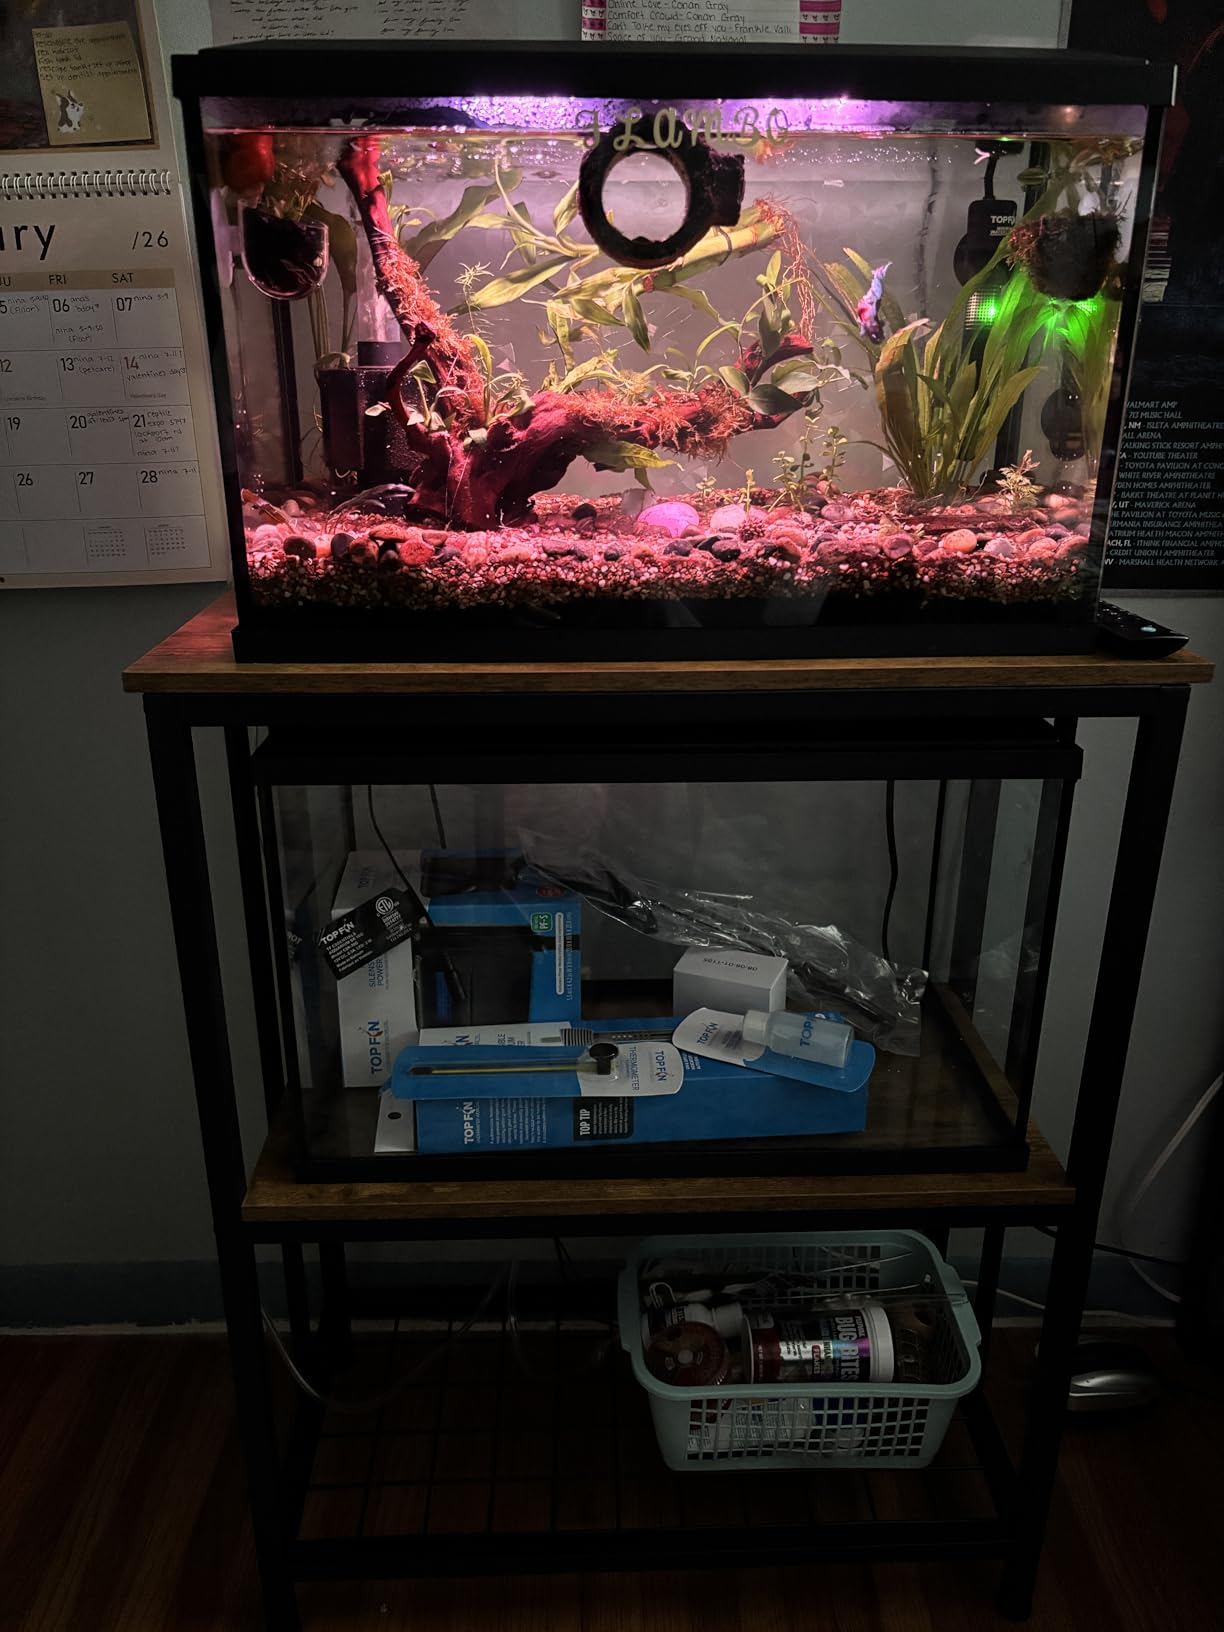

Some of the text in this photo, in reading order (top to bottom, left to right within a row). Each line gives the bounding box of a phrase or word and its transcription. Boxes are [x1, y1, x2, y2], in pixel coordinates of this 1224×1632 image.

[687, 11, 715, 21] Conan
[721, 13, 744, 26] Gray
[0, 224, 169, 261] ry /26
[48, 274, 67, 285] FRI
[111, 272, 134, 284] SAT
[53, 298, 70, 313] 06
[116, 297, 133, 312] 07
[60, 357, 75, 371] 13
[124, 355, 139, 370] 14
[1160, 400, 1179, 409] AMP
[1140, 411, 1164, 419] MUSIC
[1163, 411, 1183, 419] HALL
[7, 416, 21, 431] 19
[70, 415, 87, 429] 20
[133, 414, 147, 428] 21
[1128, 421, 1142, 429] NM
[1136, 431, 1162, 440] ARENA
[1152, 441, 1173, 450] STICK
[1173, 441, 1200, 450] RESORT
[1133, 451, 1166, 460] YOUTUBE
[1124, 462, 1155, 470] TOYOTA
[1156, 462, 1190, 470] PAVILION
[1191, 462, 1202, 470] AT
[17, 472, 33, 486] 26
[78, 471, 94, 485] 27
[140, 470, 158, 484] 28
[1118, 471, 1141, 480] WHITE
[1142, 471, 1162, 480] RIVER
[1133, 481, 1158, 490] HOMES
[1177, 491, 1189, 499] AT
[1189, 491, 1216, 500] PLANET
[1118, 501, 1130, 509] UT
[1134, 501, 1170, 509] MAVERICK
[1171, 501, 1197, 509] ARENA
[1121, 511, 1154, 519] PAVILION
[1155, 511, 1166, 519] AT
[1168, 511, 1198, 519] TOYOTA
[1142, 521, 1181, 529] INSURANCE
[1109, 530, 1136, 538] ATRIUM
[1136, 530, 1164, 538] HEALTH
[1165, 530, 1193, 538] MACON
[1161, 540, 1199, 548] FINANCIAL
[1109, 549, 1132, 557] CREDIT
[1133, 549, 1158, 557] UNION
[1118, 558, 1155, 566] MARSHALL
[1156, 558, 1183, 566] HEALTH
[1184, 558, 1218, 566] NETWORK
[376, 958, 384, 986] POWER
[629, 1046, 640, 1091] THERMOMETER
[579, 1108, 591, 1136] TOP TIP
[835, 1316, 860, 1382] BUG BITES
